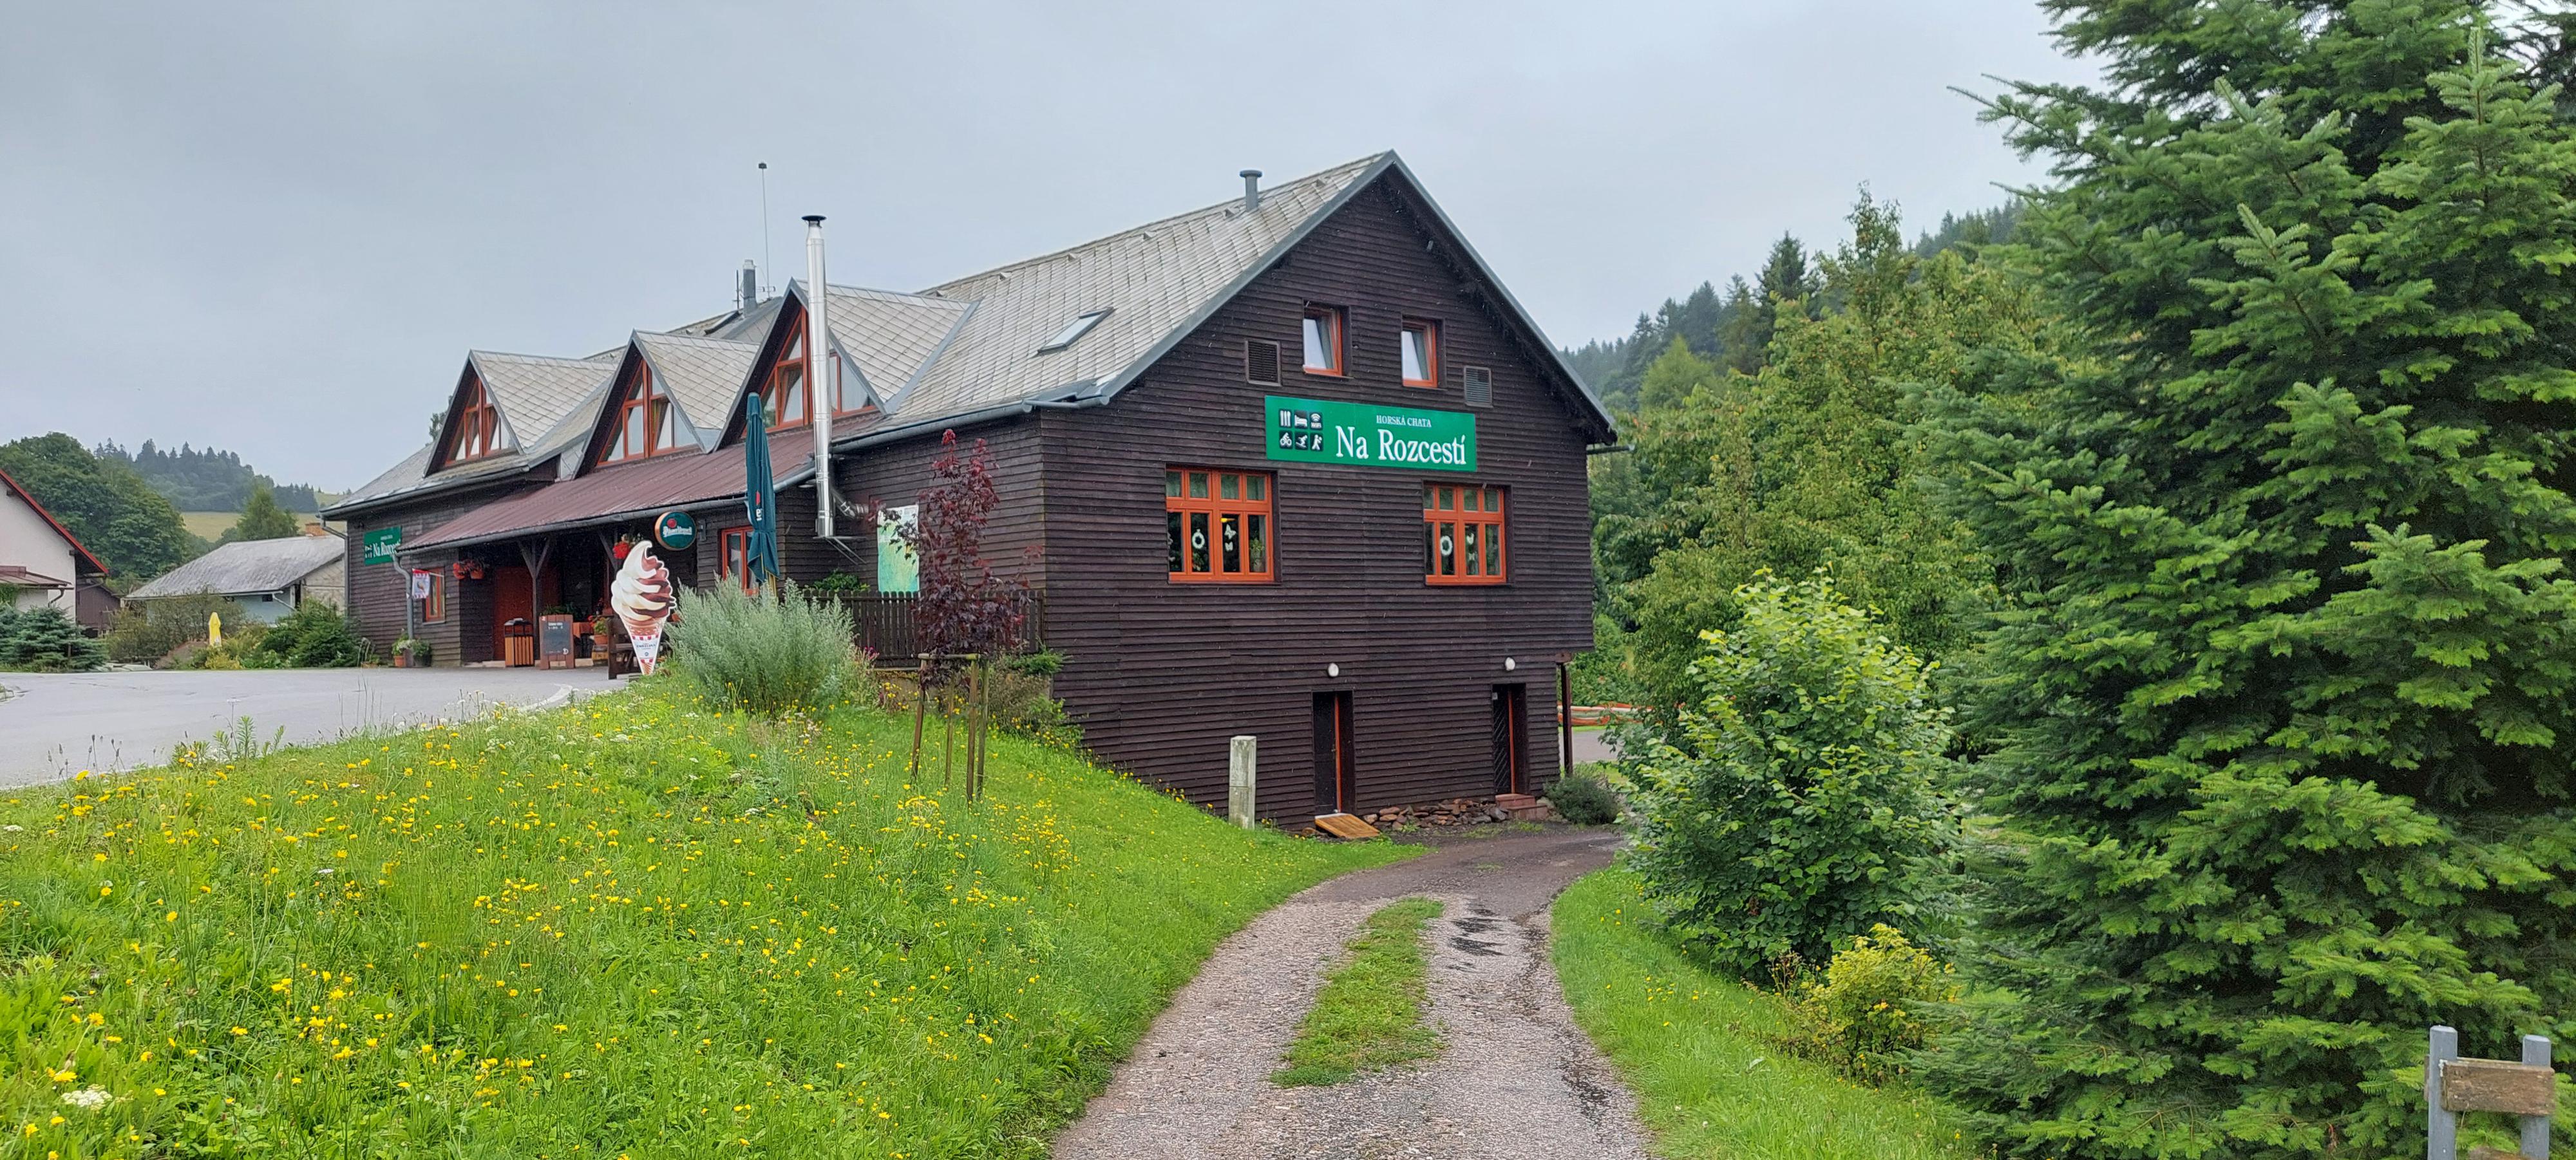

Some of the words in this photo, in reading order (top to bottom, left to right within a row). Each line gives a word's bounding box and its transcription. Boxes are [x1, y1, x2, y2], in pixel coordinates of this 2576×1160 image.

[1376, 415, 1406, 426] HORSKÁ
[1406, 417, 1432, 427] CHATA
[1335, 426, 1369, 459] Na
[1378, 429, 1466, 465] Rozcestí
[372, 543, 381, 558] Na
